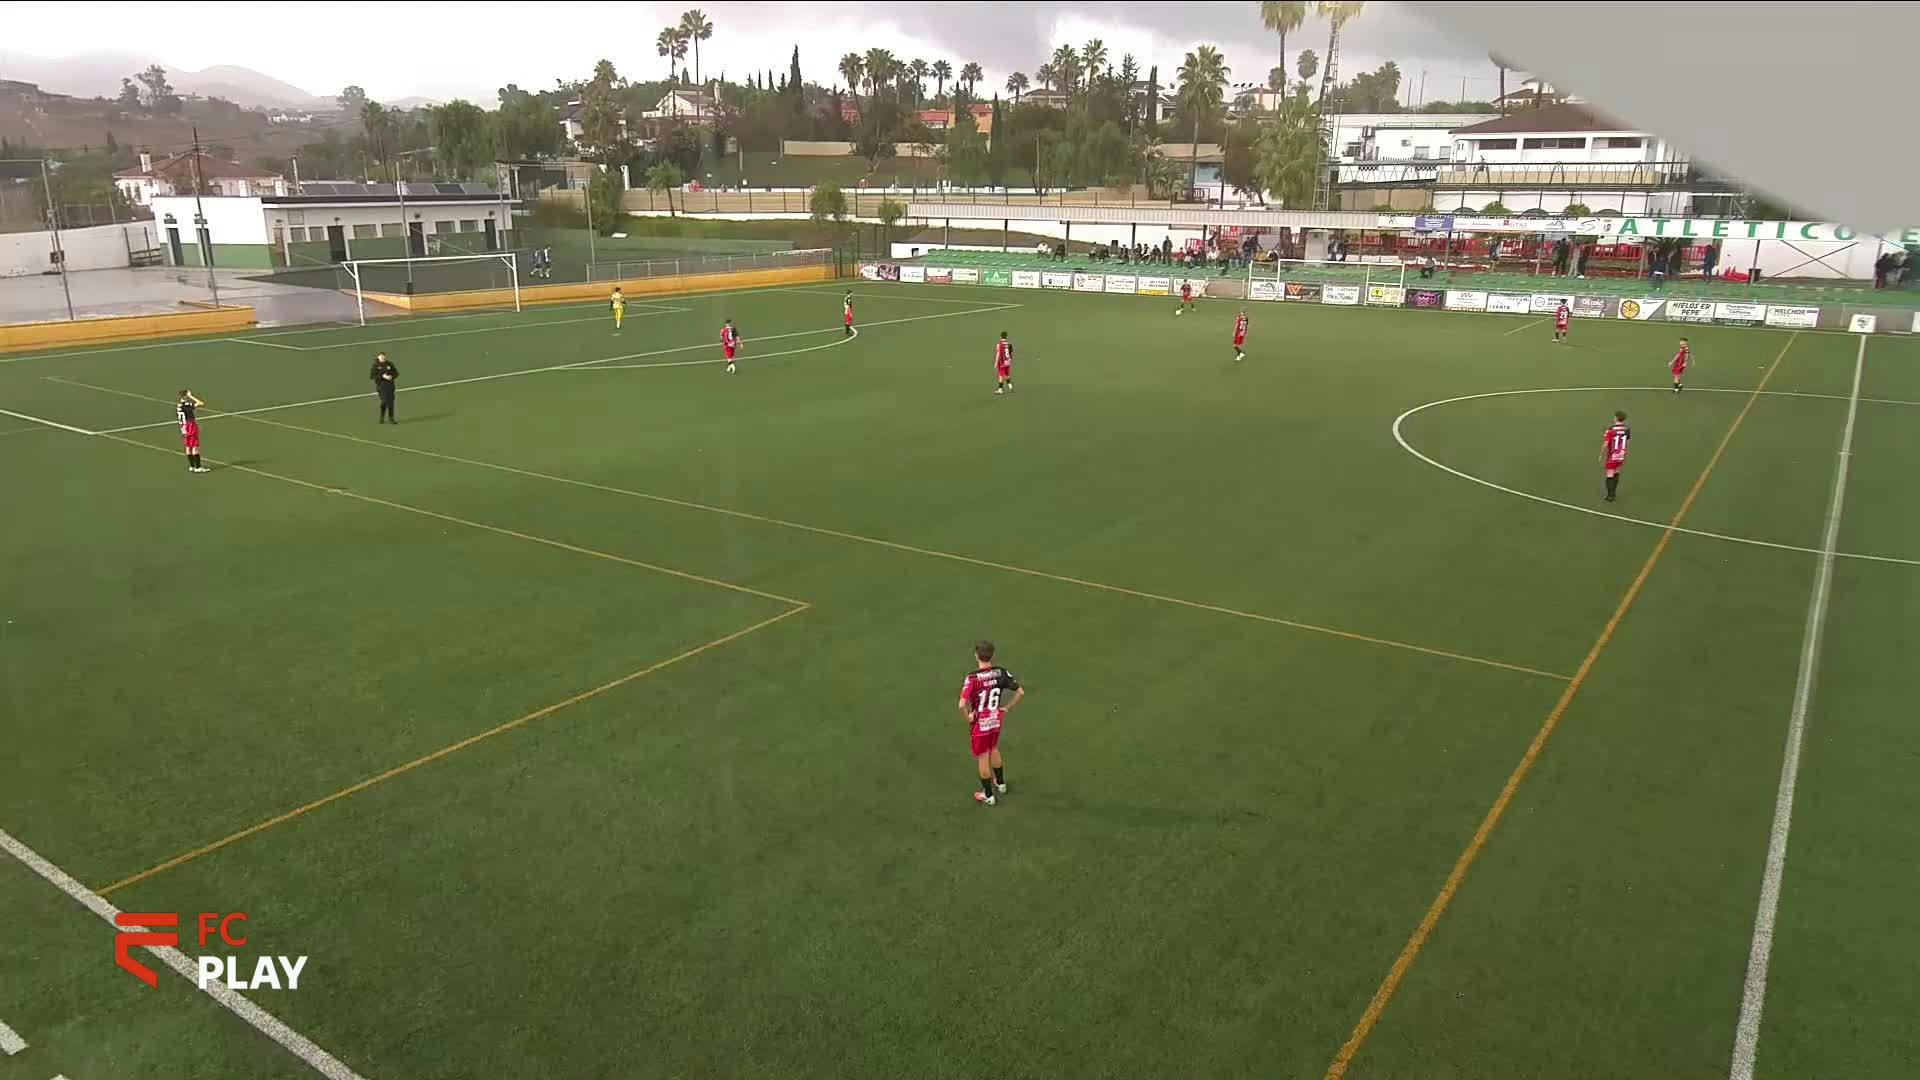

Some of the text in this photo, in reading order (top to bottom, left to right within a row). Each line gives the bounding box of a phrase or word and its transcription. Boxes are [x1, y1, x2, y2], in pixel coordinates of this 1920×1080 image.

[1618, 218, 1857, 241] ATLETICO
[1613, 435, 1627, 450] 11
[978, 687, 1001, 713] 16
